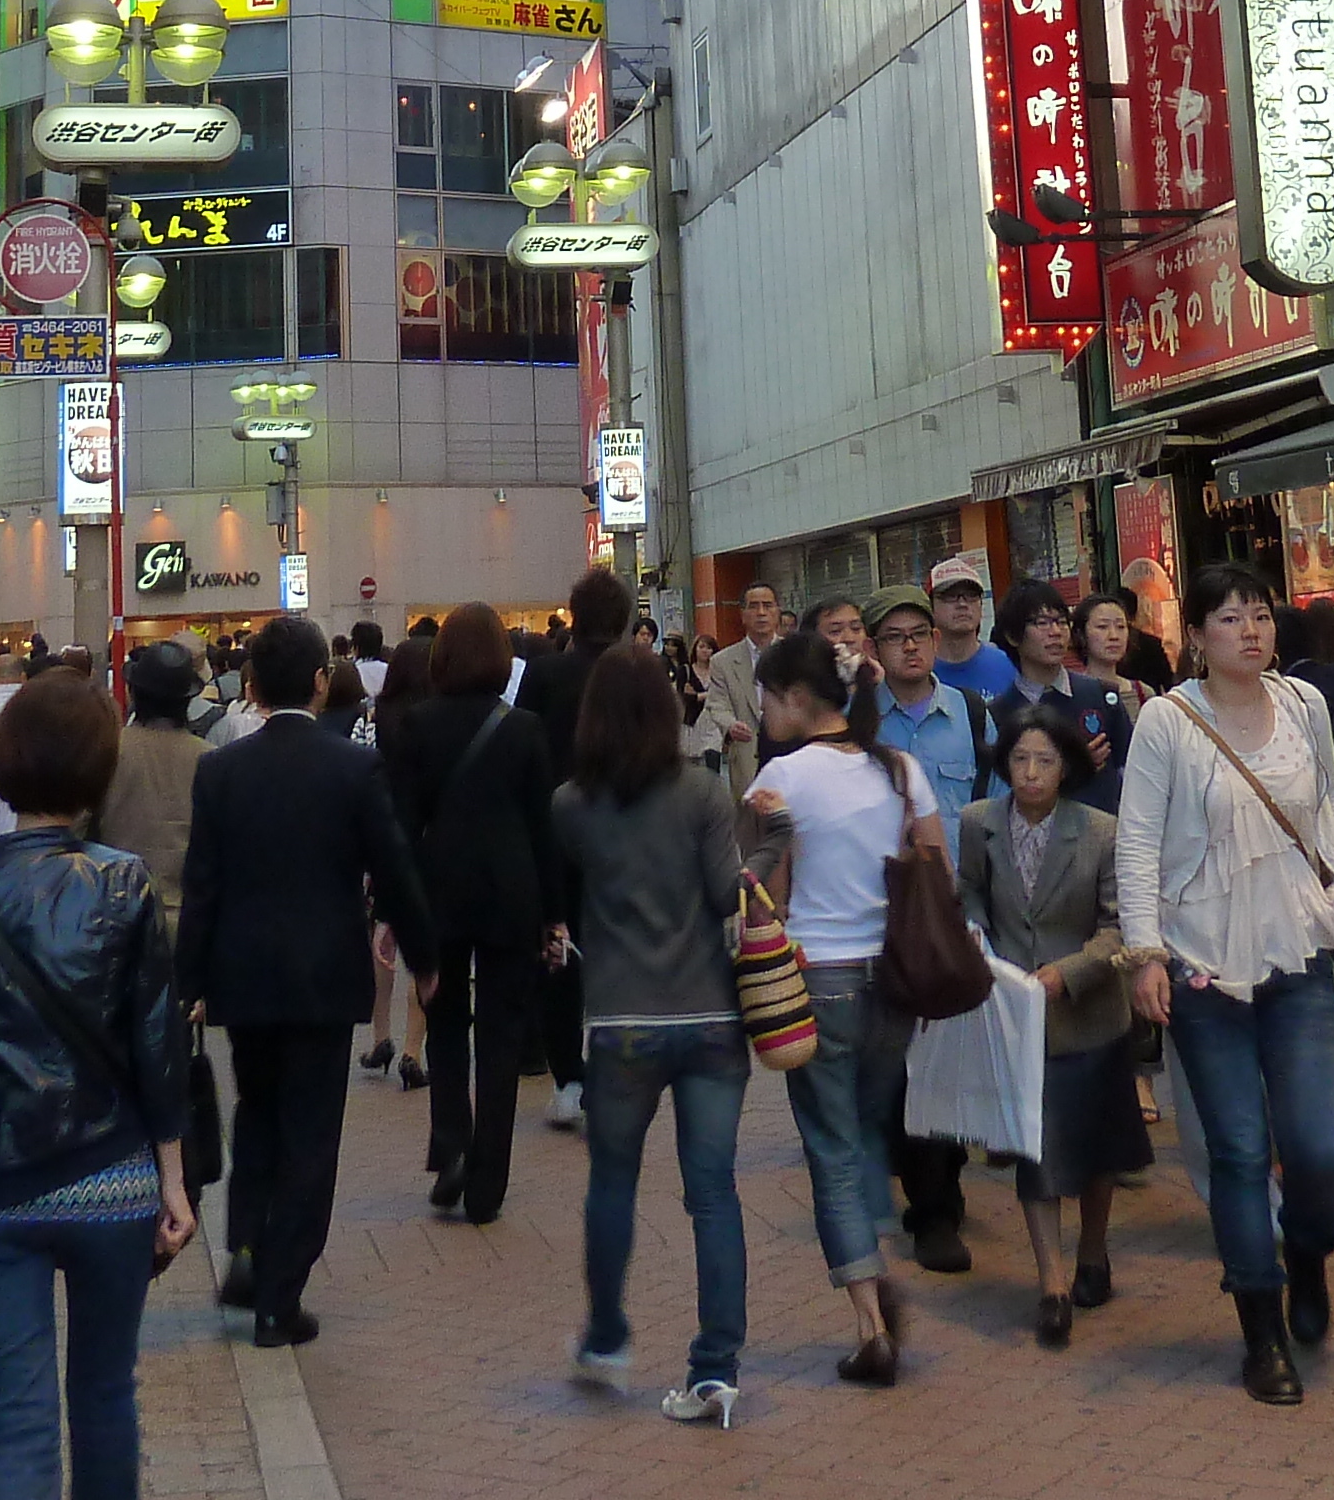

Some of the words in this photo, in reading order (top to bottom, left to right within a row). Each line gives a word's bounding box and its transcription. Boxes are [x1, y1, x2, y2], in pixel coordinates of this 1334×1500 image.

[45, 120, 229, 143] 渋谷センター街
[16, 227, 35, 238] FIRE
[36, 226, 75, 238] HYDRANT
[266, 223, 287, 240] 4F
[520, 233, 650, 253] 渋谷センター街
[8, 241, 83, 276] 消火栓
[31, 321, 103, 334] 3464-2061
[20, 333, 104, 360] セキネ
[67, 387, 109, 403] HAVE
[603, 432, 633, 445] HAVE
[635, 432, 642, 444] A
[604, 444, 642, 457] DREAM!
[191, 571, 260, 588] KAWANO
